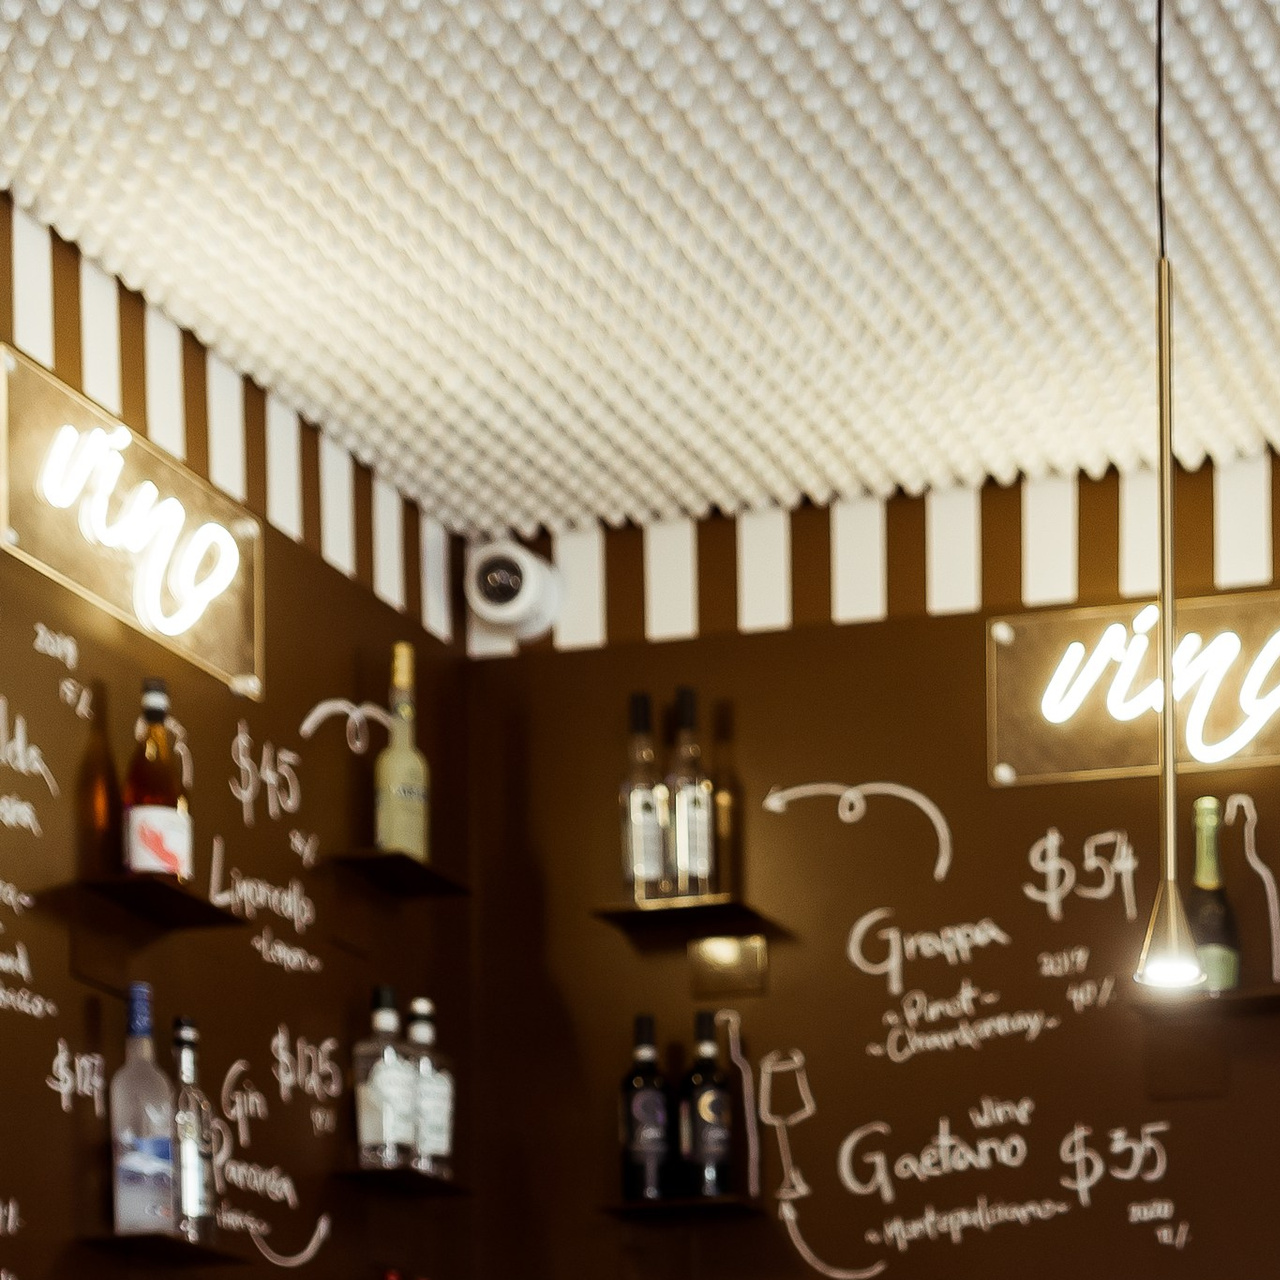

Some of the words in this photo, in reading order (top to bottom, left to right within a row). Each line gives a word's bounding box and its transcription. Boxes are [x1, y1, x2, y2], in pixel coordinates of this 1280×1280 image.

[34, 423, 240, 636] vino
[846, 906, 1011, 996] Grappa
[837, 1116, 1029, 1204] Gaetano
[1058, 1121, 1170, 1208] $35
